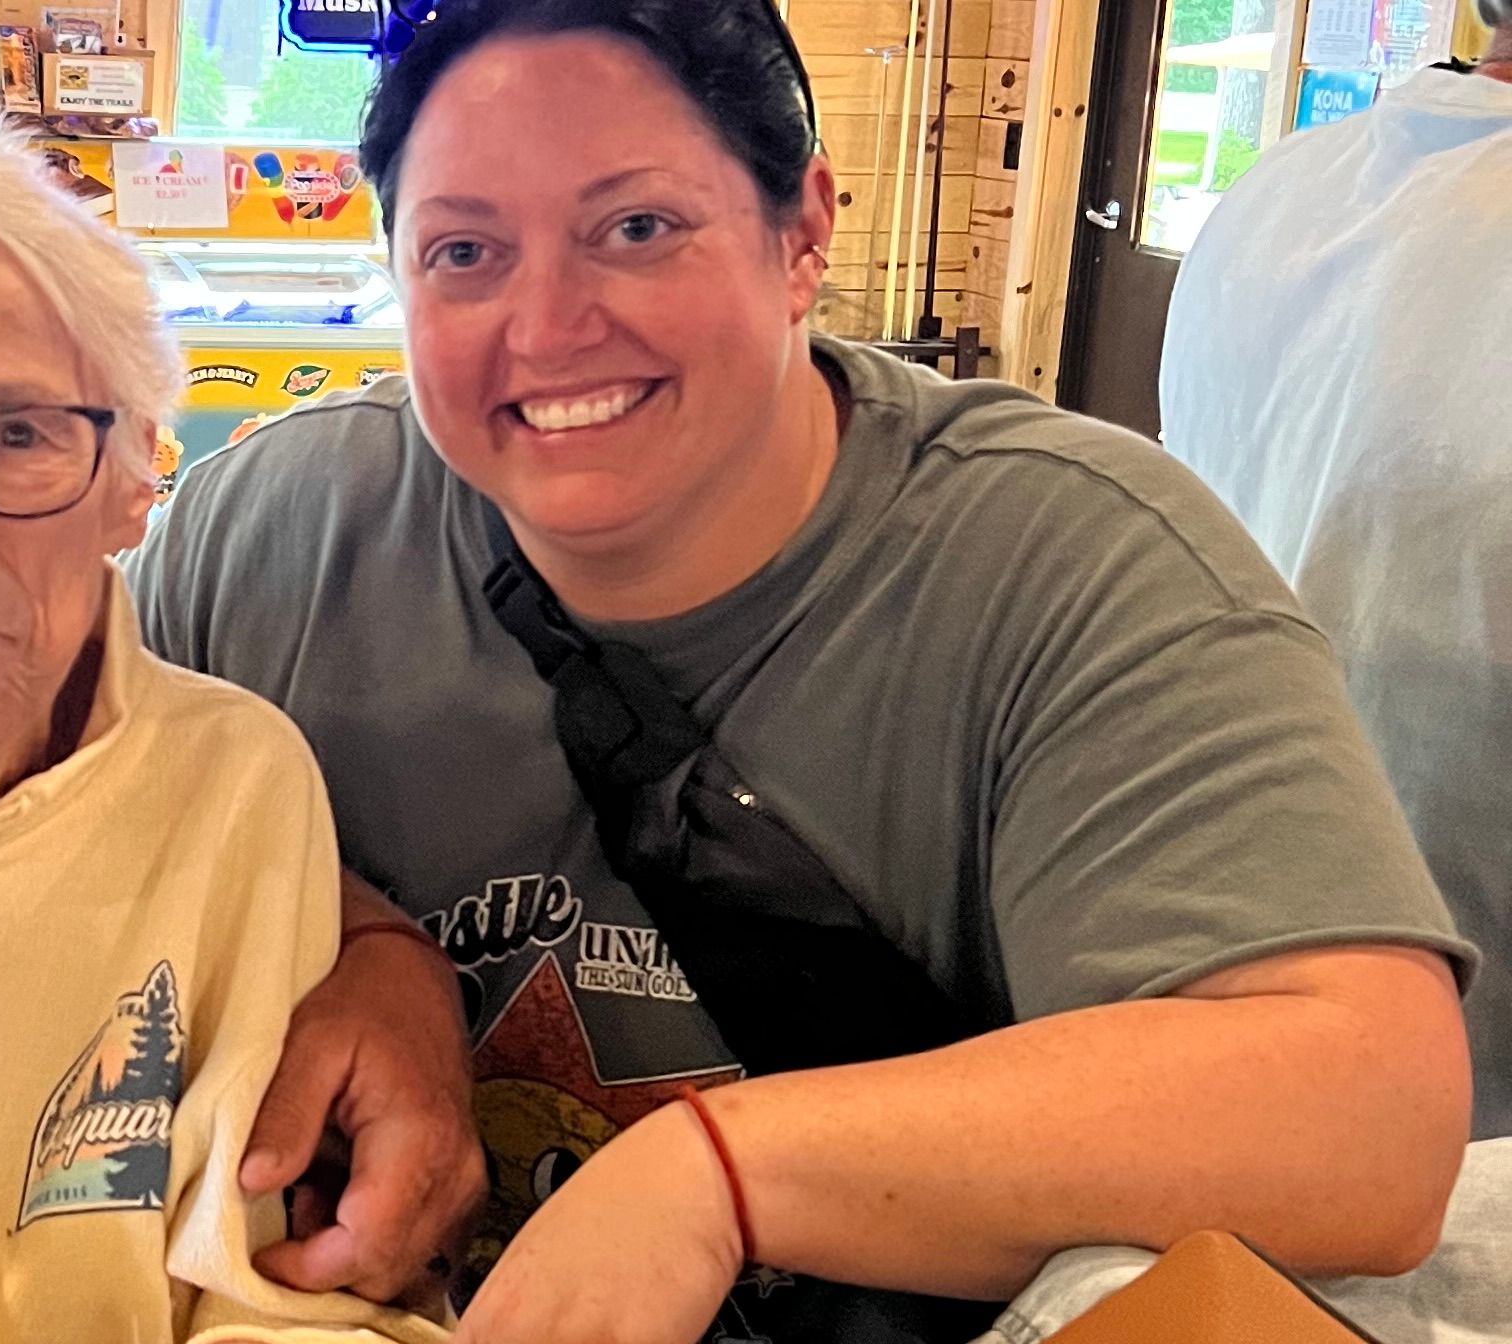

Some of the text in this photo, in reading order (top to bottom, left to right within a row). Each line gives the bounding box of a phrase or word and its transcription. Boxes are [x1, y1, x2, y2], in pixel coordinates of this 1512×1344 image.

[60, 96, 86, 106] ENJOY
[1313, 88, 1353, 110] KONA
[133, 176, 201, 186] ICE CREAM
[417, 874, 582, 967] stle
[582, 923, 677, 972] UNT
[579, 966, 608, 988] THE
[614, 970, 645, 992] SUN
